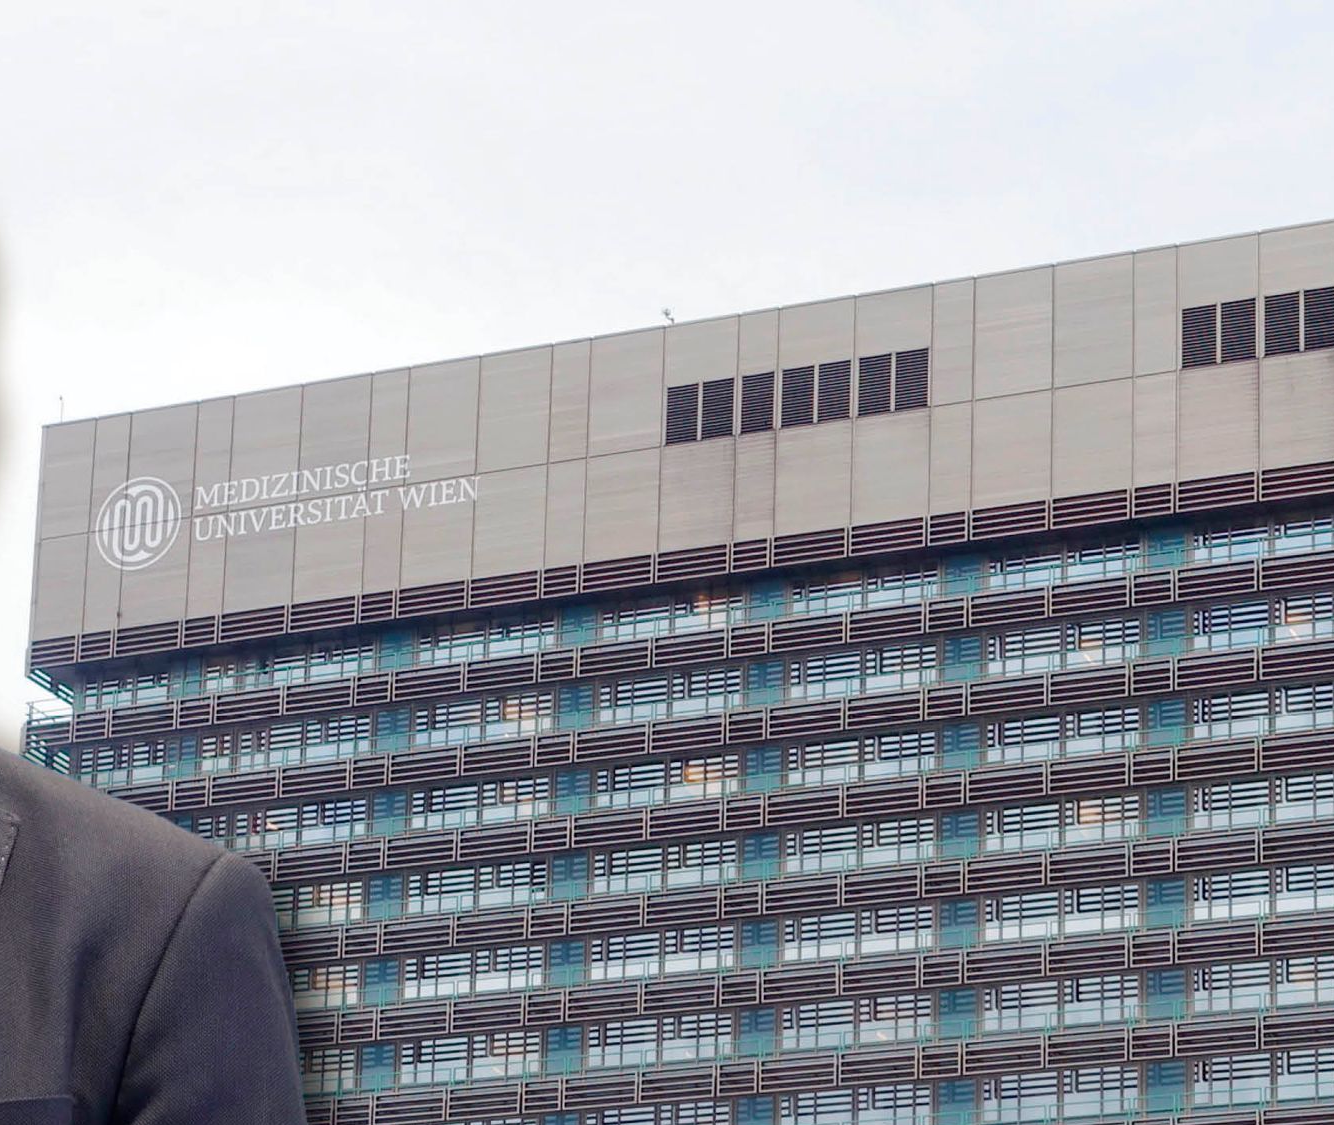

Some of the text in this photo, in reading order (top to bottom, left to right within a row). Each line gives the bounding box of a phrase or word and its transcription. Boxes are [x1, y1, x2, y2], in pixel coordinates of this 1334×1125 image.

[194, 476, 482, 542] UNIVERSITÄT WIEN
[195, 454, 411, 510] MEDIZINISCHE
